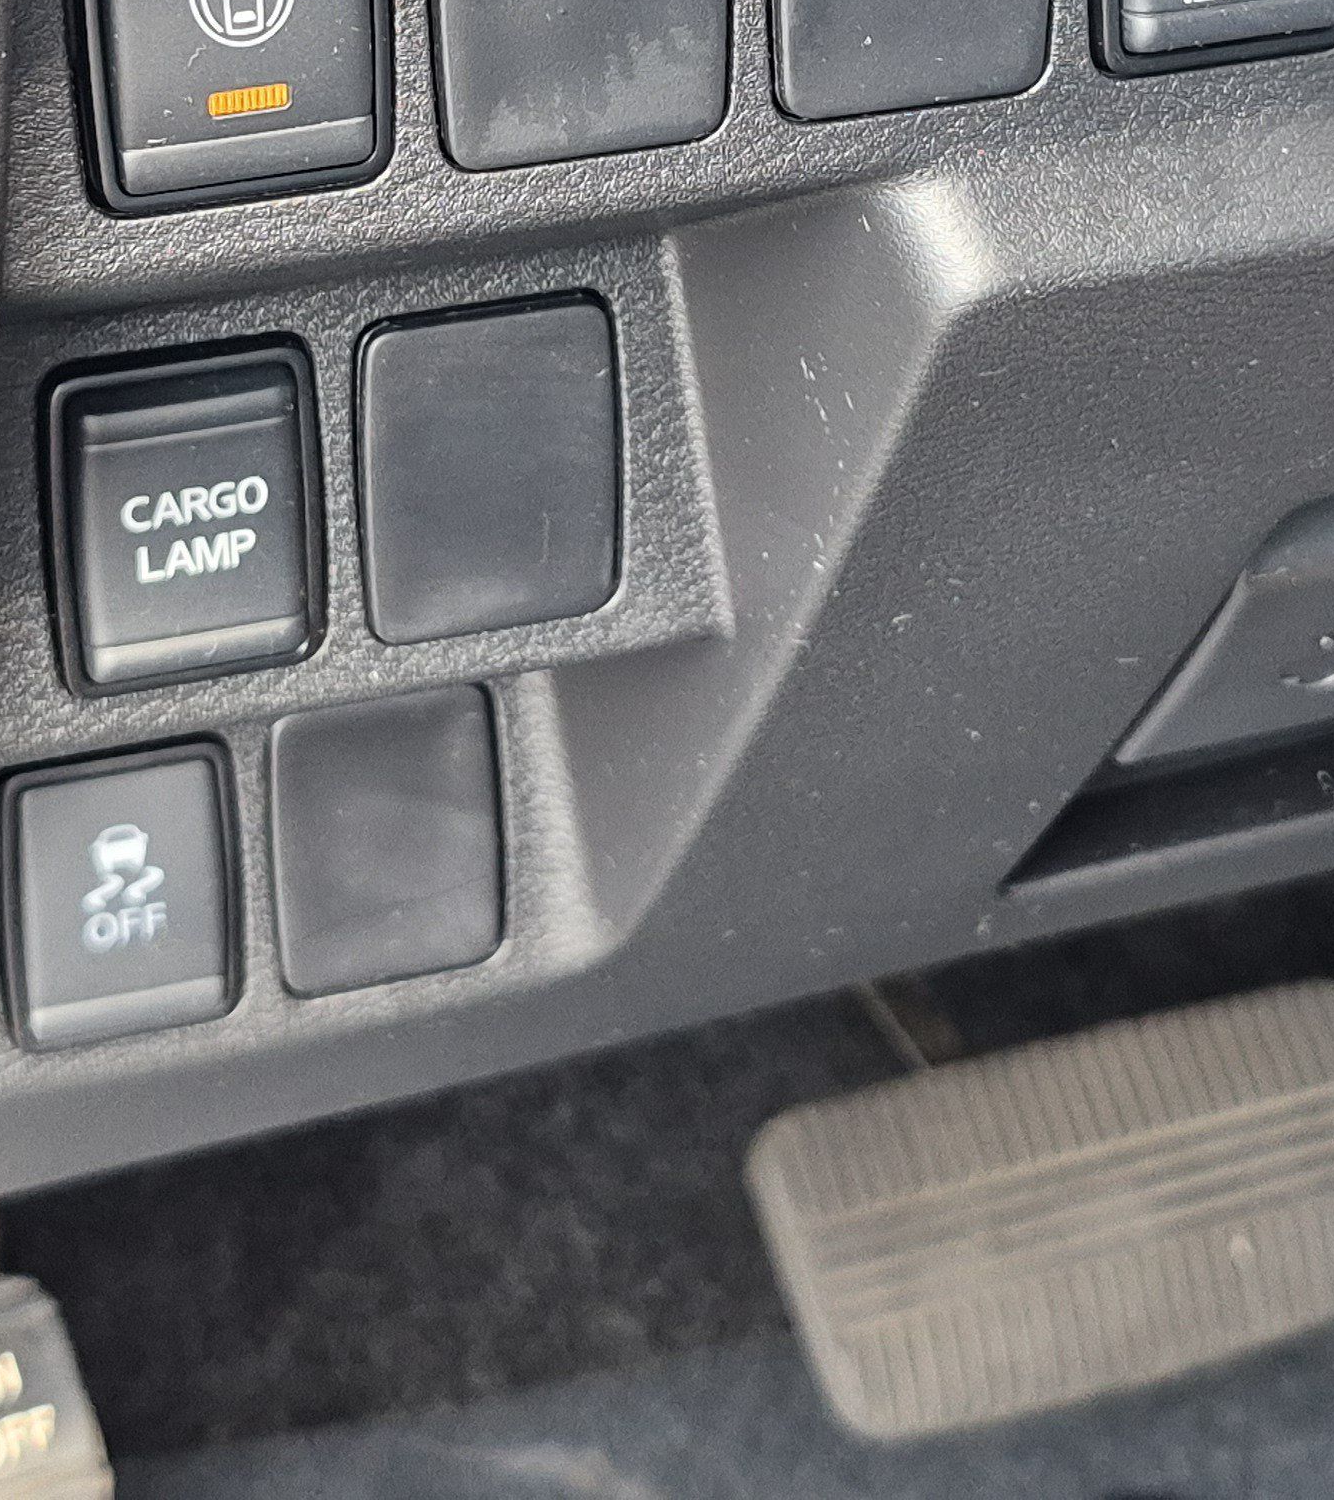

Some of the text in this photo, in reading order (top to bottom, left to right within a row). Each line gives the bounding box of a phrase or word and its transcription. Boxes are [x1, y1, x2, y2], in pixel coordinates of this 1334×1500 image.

[120, 475, 269, 534] CARGO
[136, 528, 256, 584] LAMP
[82, 901, 167, 952] OFF
